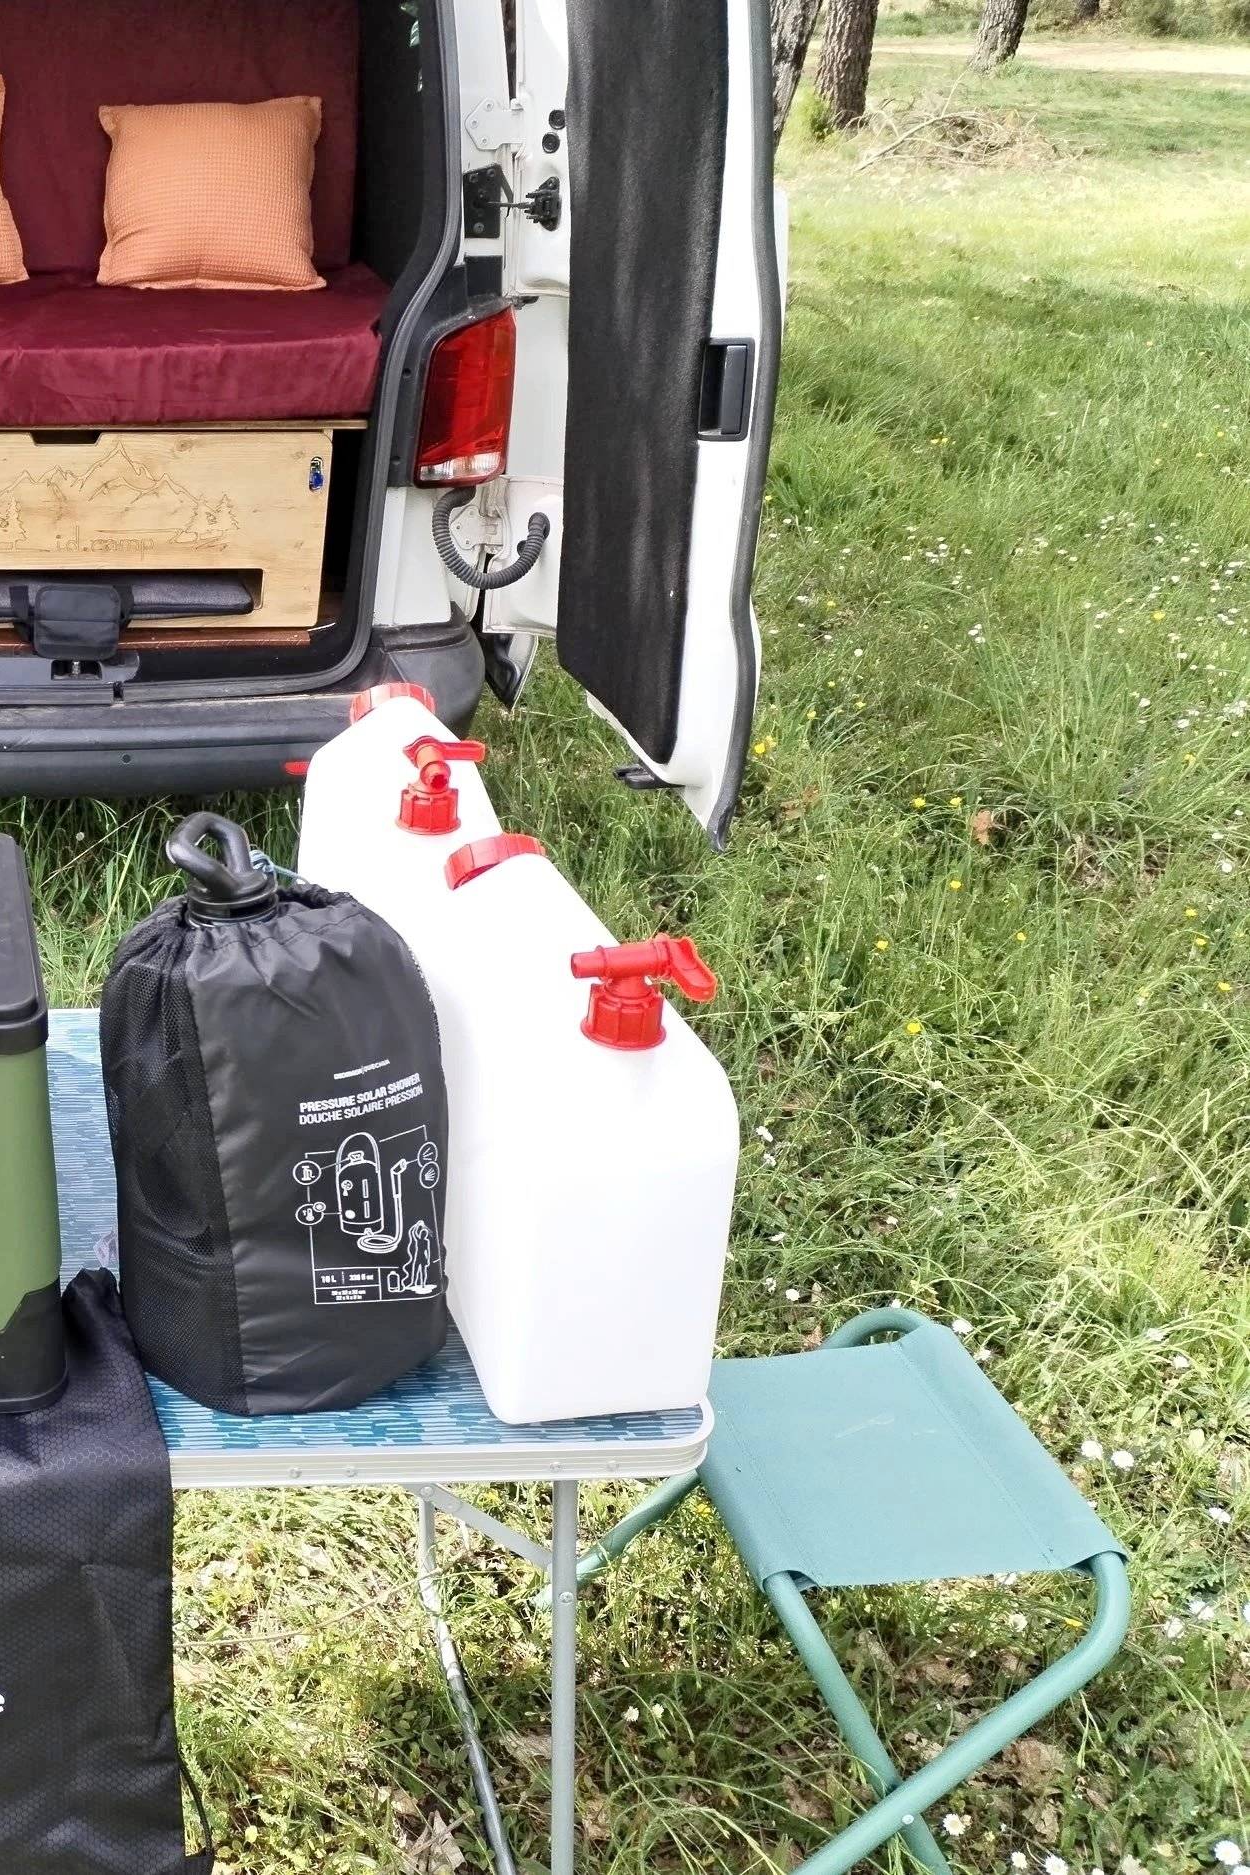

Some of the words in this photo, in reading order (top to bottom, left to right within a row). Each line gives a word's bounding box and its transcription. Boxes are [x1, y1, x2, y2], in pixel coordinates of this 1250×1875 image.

[299, 1095, 356, 1113] PRESSURE
[357, 1086, 388, 1104] SOLAR
[387, 1072, 421, 1094] SHOWER
[299, 1109, 343, 1125] DOUCHE
[343, 1101, 384, 1119] SOLAIRE
[385, 1084, 423, 1109] PRESSION
